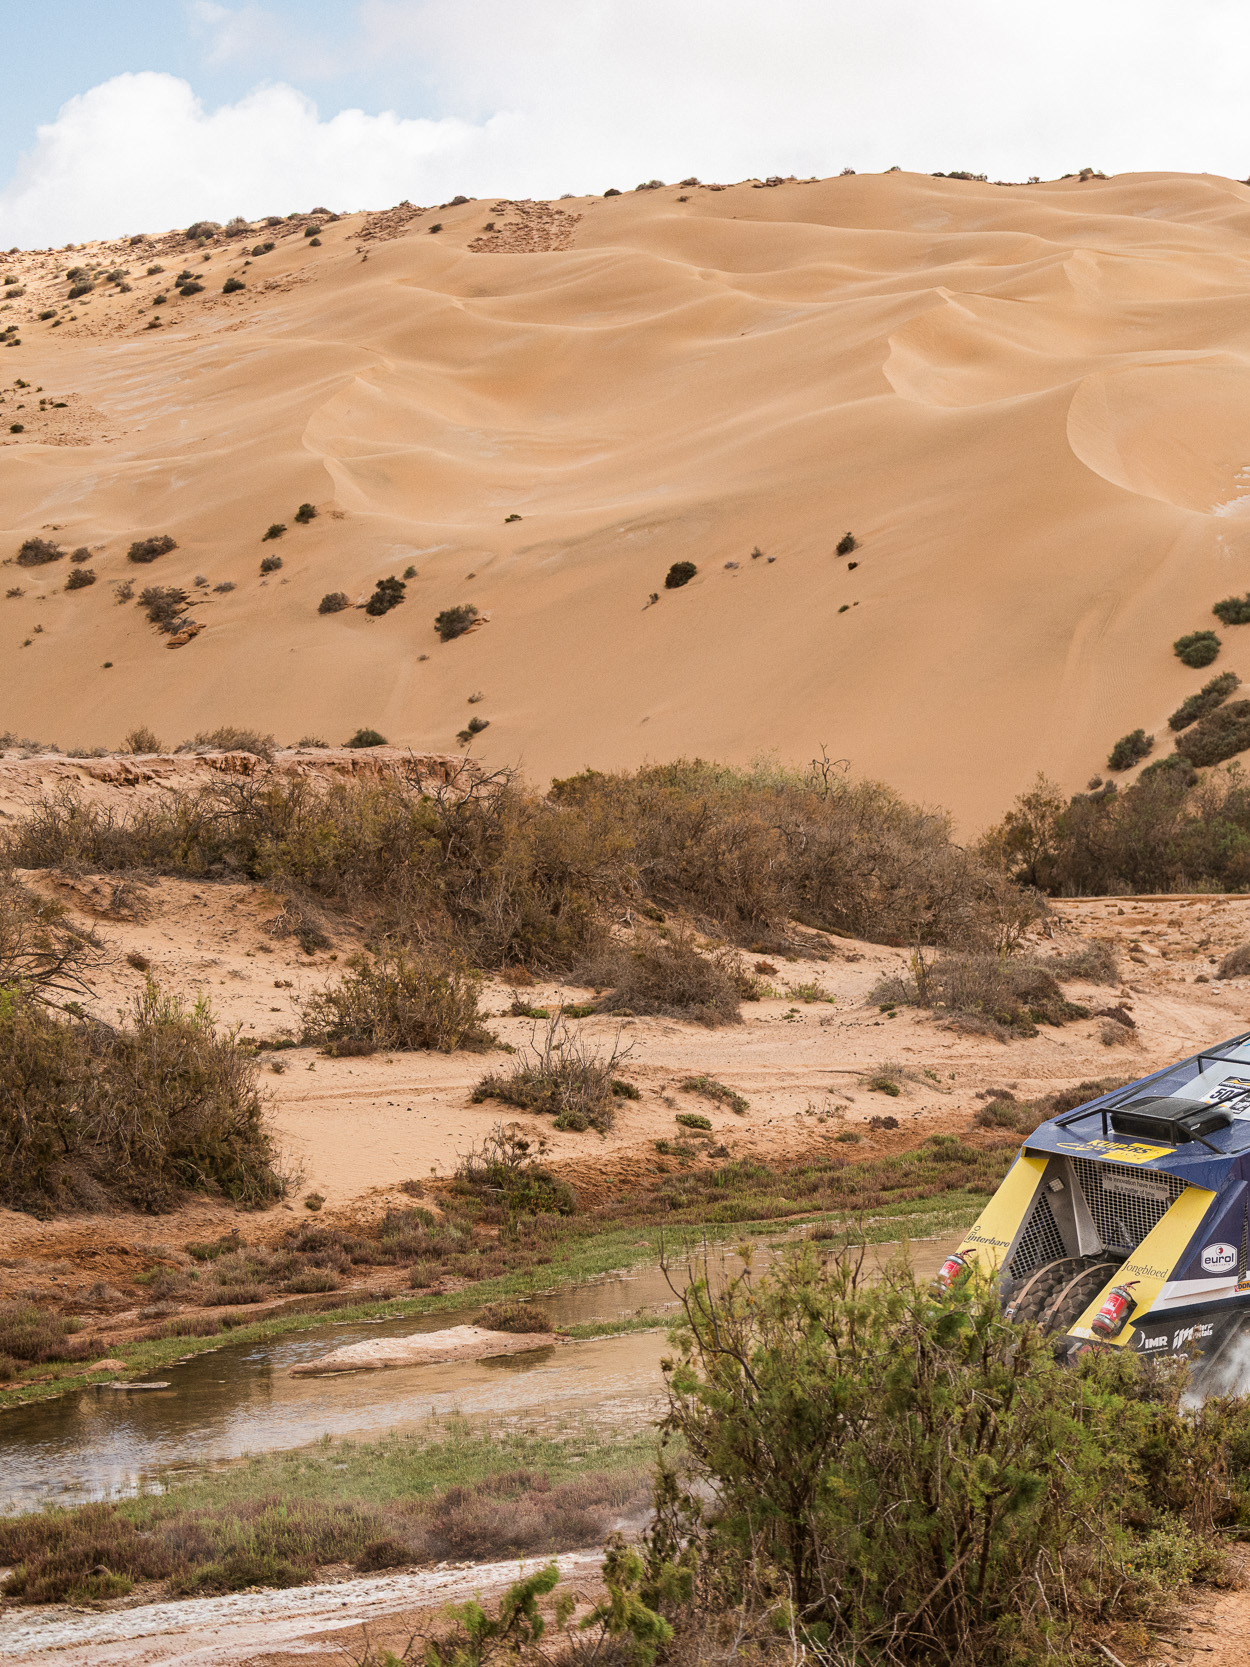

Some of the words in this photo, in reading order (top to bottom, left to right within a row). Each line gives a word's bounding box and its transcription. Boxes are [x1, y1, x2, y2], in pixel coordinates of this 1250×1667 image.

[1209, 1088, 1240, 1103] 50
[1086, 1139, 1153, 1154] KUIPERS
[1113, 1177, 1136, 1187] innovation
[1137, 1181, 1148, 1189] have
[1155, 1184, 1168, 1192] limits
[965, 1232, 1011, 1248] interbaro
[1204, 1253, 1235, 1264] eurol
[1121, 1260, 1169, 1278] Jongbloed
[1144, 1335, 1168, 1349] IMR
